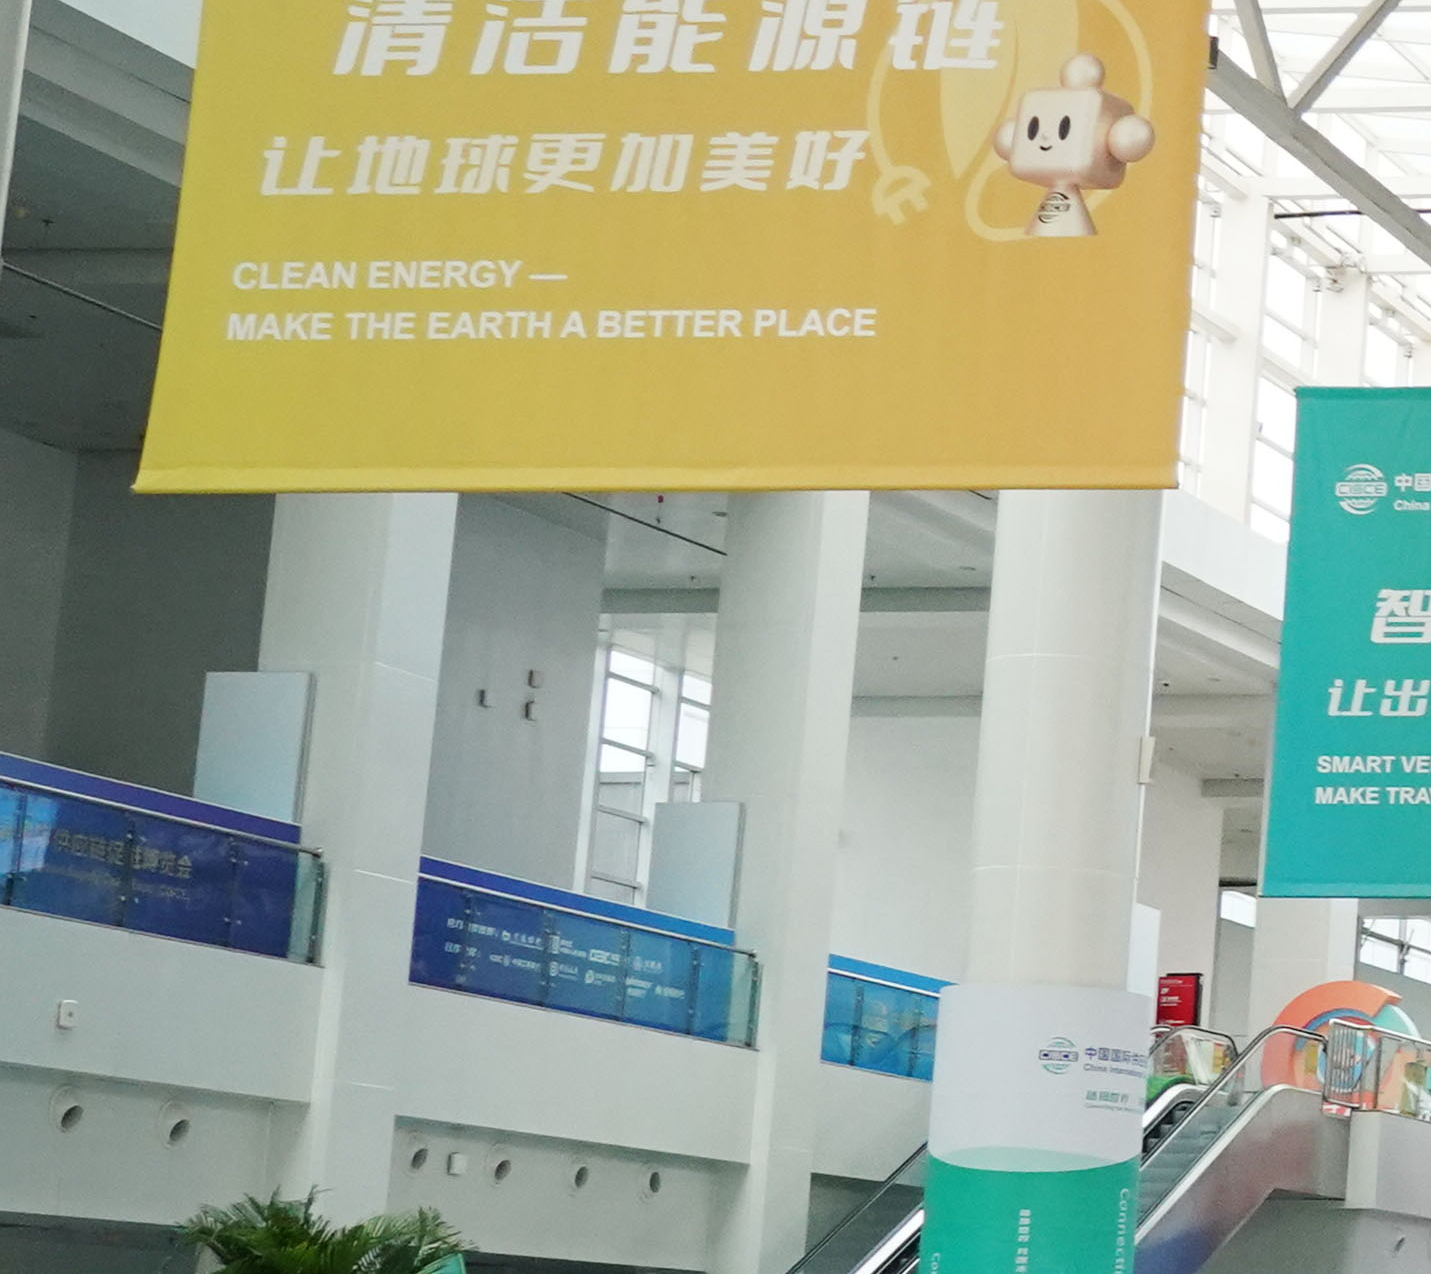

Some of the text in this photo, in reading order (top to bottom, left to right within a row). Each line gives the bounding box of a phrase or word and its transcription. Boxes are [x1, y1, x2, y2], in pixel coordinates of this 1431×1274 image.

[259, 128, 870, 197] 让地球更加美好
[233, 260, 523, 289] CLEAN ENERGY
[227, 308, 876, 340] MAKE THE EARTH A BETTER PLACE
[1394, 500, 1431, 511] China
[1317, 756, 1396, 773] SMART
[1315, 787, 1380, 804] MAKE
